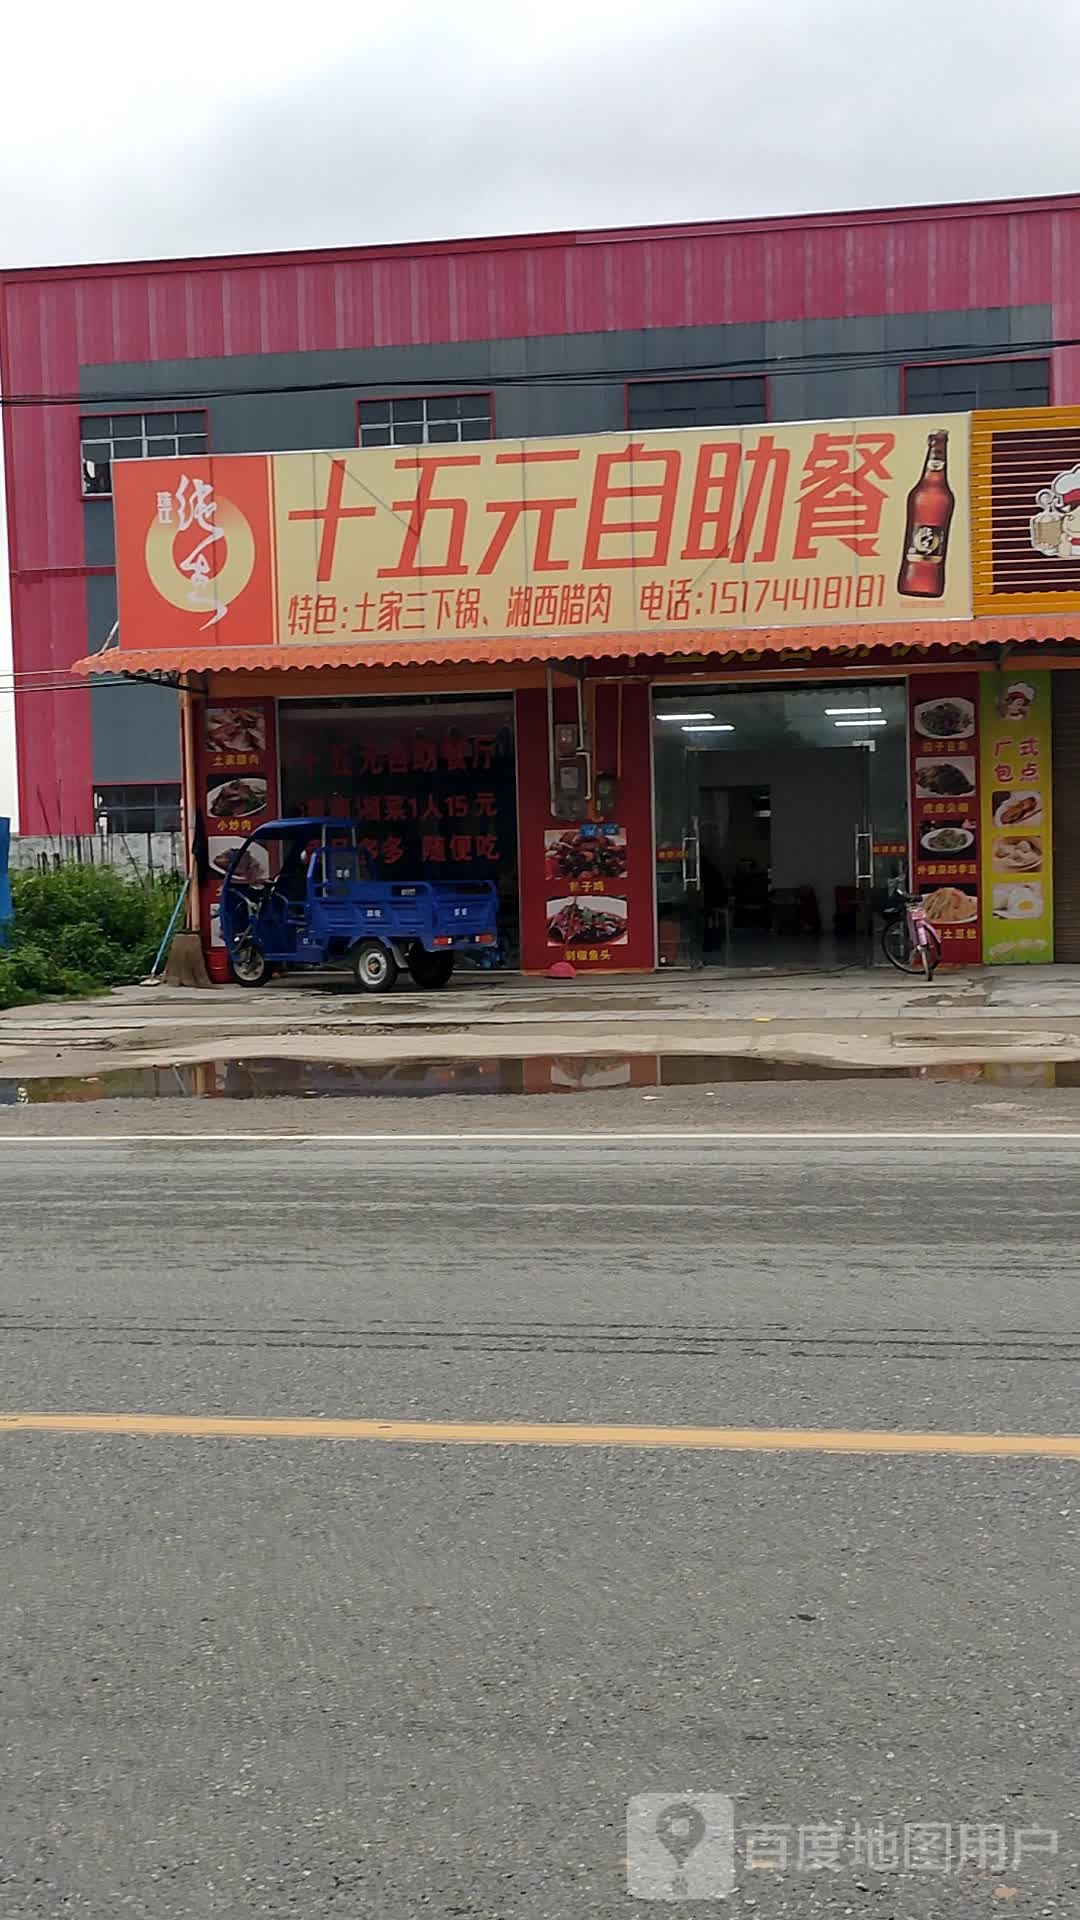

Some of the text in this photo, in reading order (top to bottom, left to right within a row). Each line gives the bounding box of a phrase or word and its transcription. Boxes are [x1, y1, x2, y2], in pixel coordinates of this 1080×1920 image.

[287, 431, 896, 582] 十五元自助餐
[287, 574, 886, 636] 特色:土家三下锅、湘西腊肉 电话:15174418181
